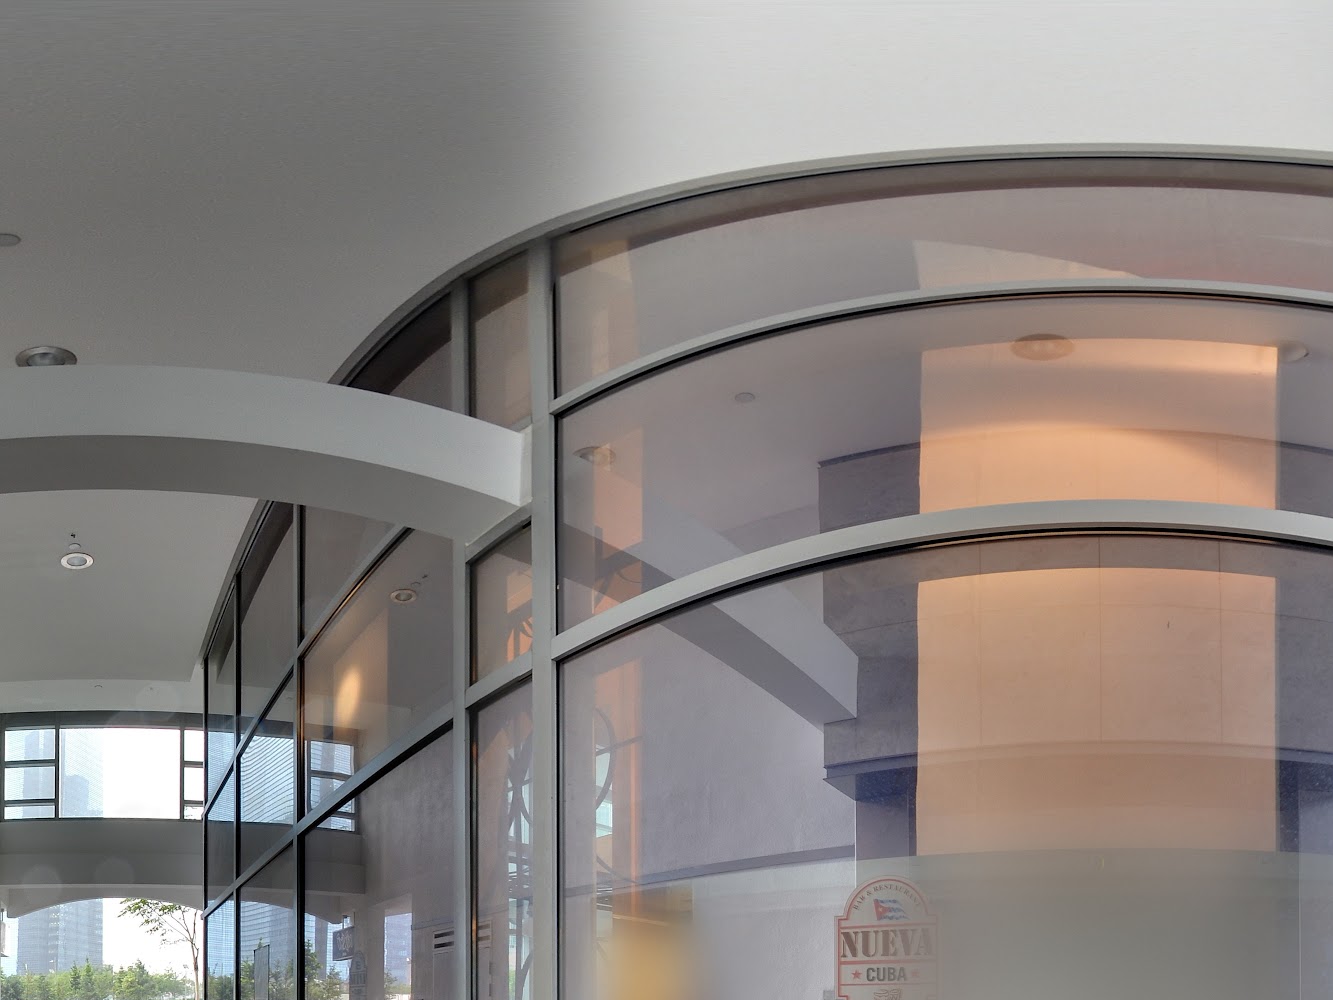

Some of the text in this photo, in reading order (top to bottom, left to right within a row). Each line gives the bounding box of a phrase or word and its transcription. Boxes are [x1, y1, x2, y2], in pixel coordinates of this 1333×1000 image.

[853, 893, 866, 911] BAR
[873, 884, 922, 908] RESTAURANT
[840, 927, 934, 958] NUEVA
[866, 966, 907, 982] CUBA
